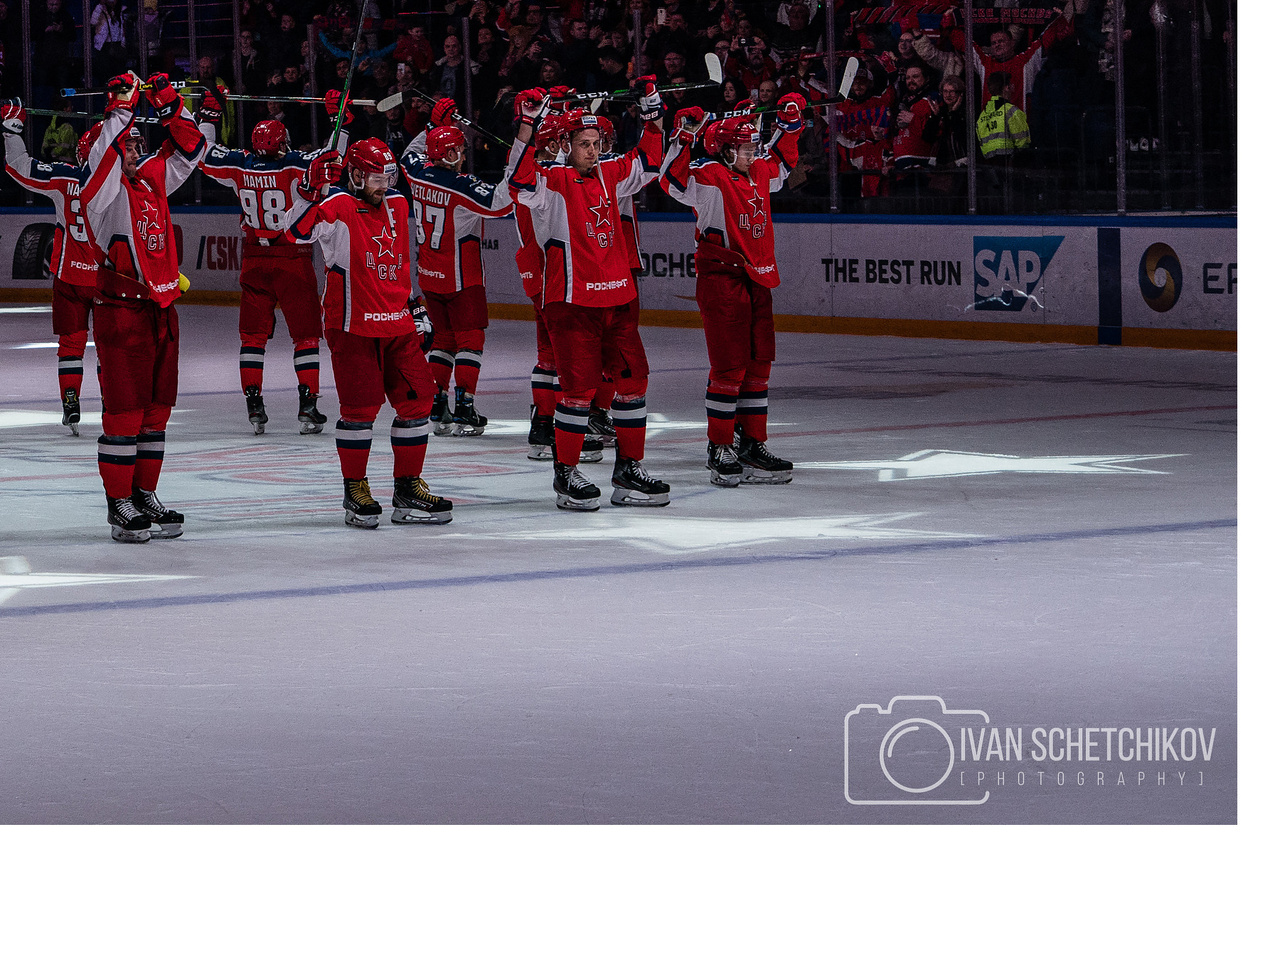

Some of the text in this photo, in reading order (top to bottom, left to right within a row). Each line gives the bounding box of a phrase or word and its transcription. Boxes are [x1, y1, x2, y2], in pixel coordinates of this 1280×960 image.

[576, 90, 609, 100] CCM
[723, 108, 751, 119] CCM
[243, 173, 277, 189] MAMIN
[410, 180, 451, 207] VETLAKOV
[238, 189, 287, 233] 98
[821, 258, 962, 287] THE BEST RUN
[975, 248, 1042, 298] SAP
[586, 278, 629, 291] РОСНЕФТ
